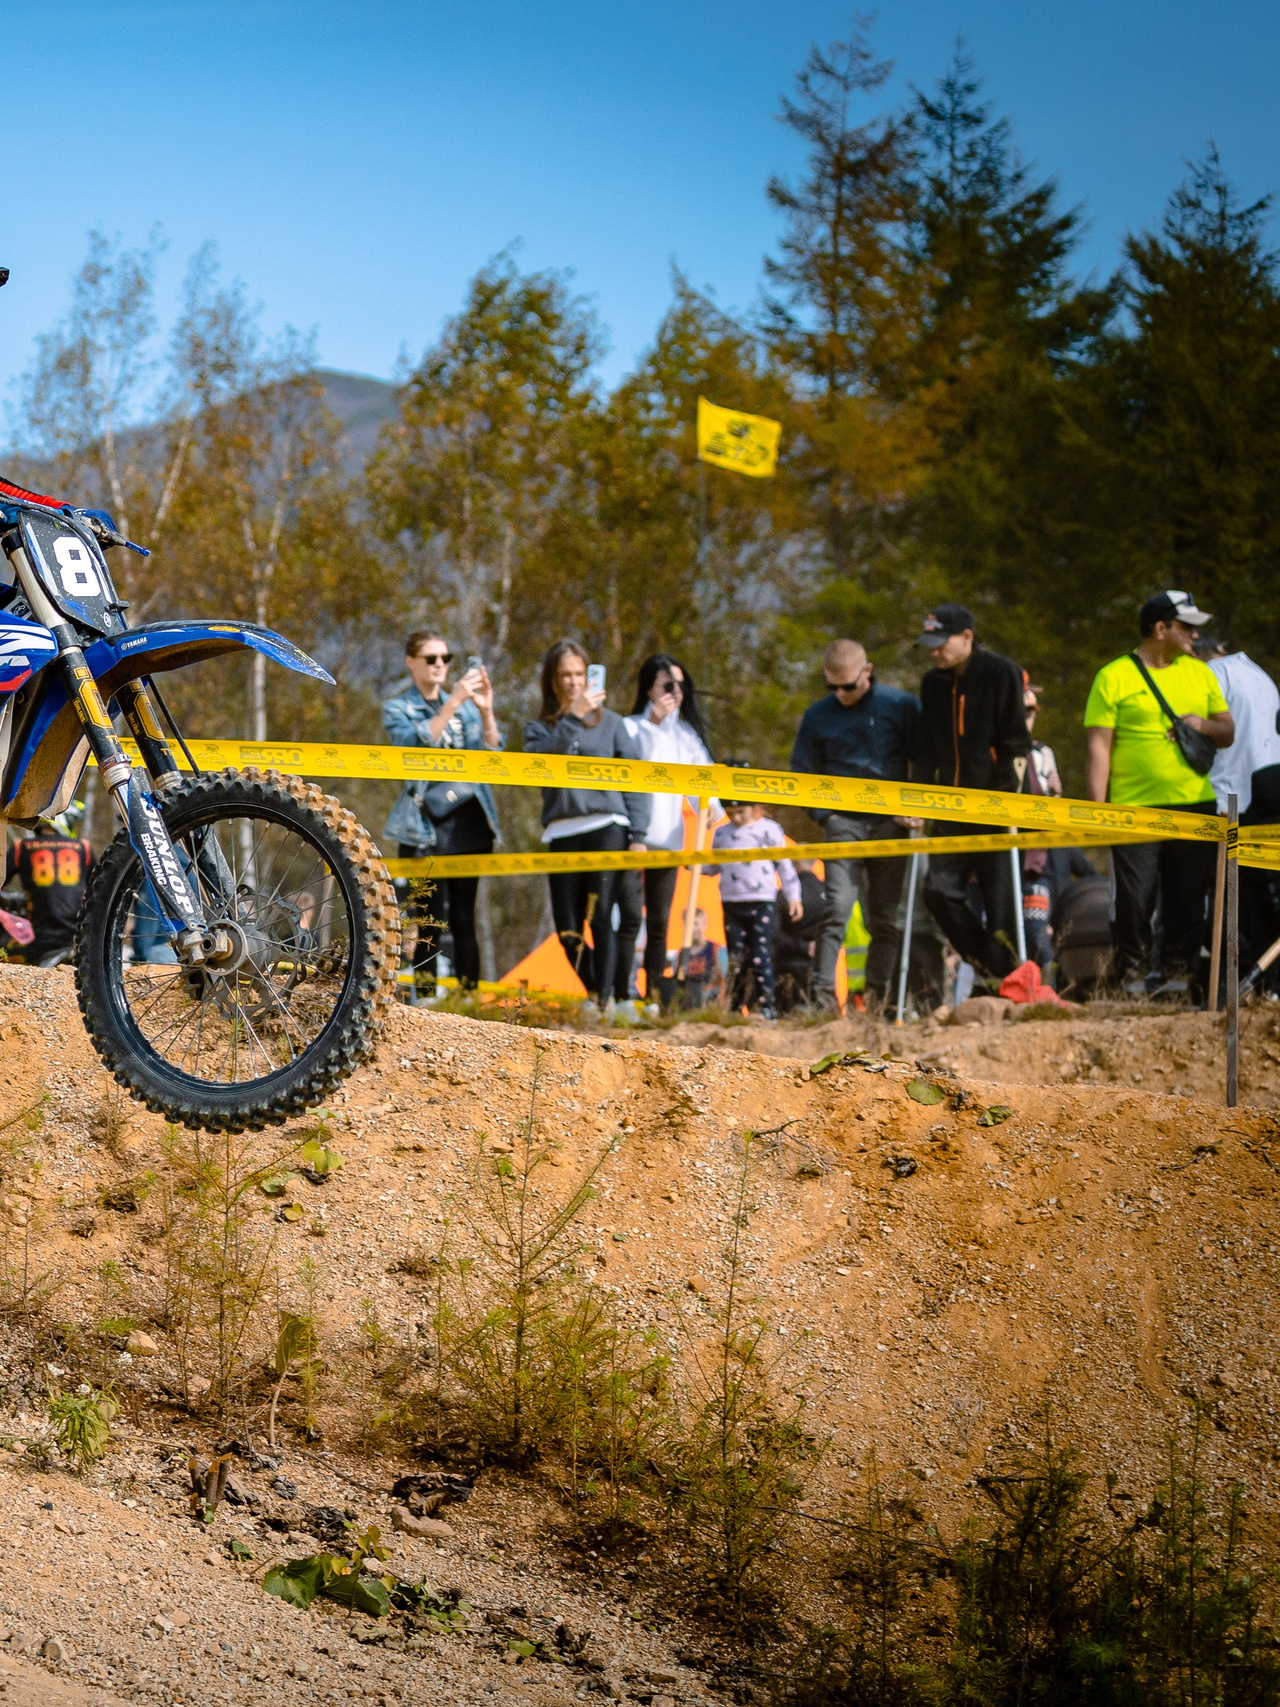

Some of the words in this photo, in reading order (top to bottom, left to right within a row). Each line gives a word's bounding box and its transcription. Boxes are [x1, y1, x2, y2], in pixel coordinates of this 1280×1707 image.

[126, 636, 148, 648] YAMAHA
[30, 848, 81, 888] 88
[140, 797, 195, 914] DUNLOP
[141, 833, 168, 886] BRAKING
